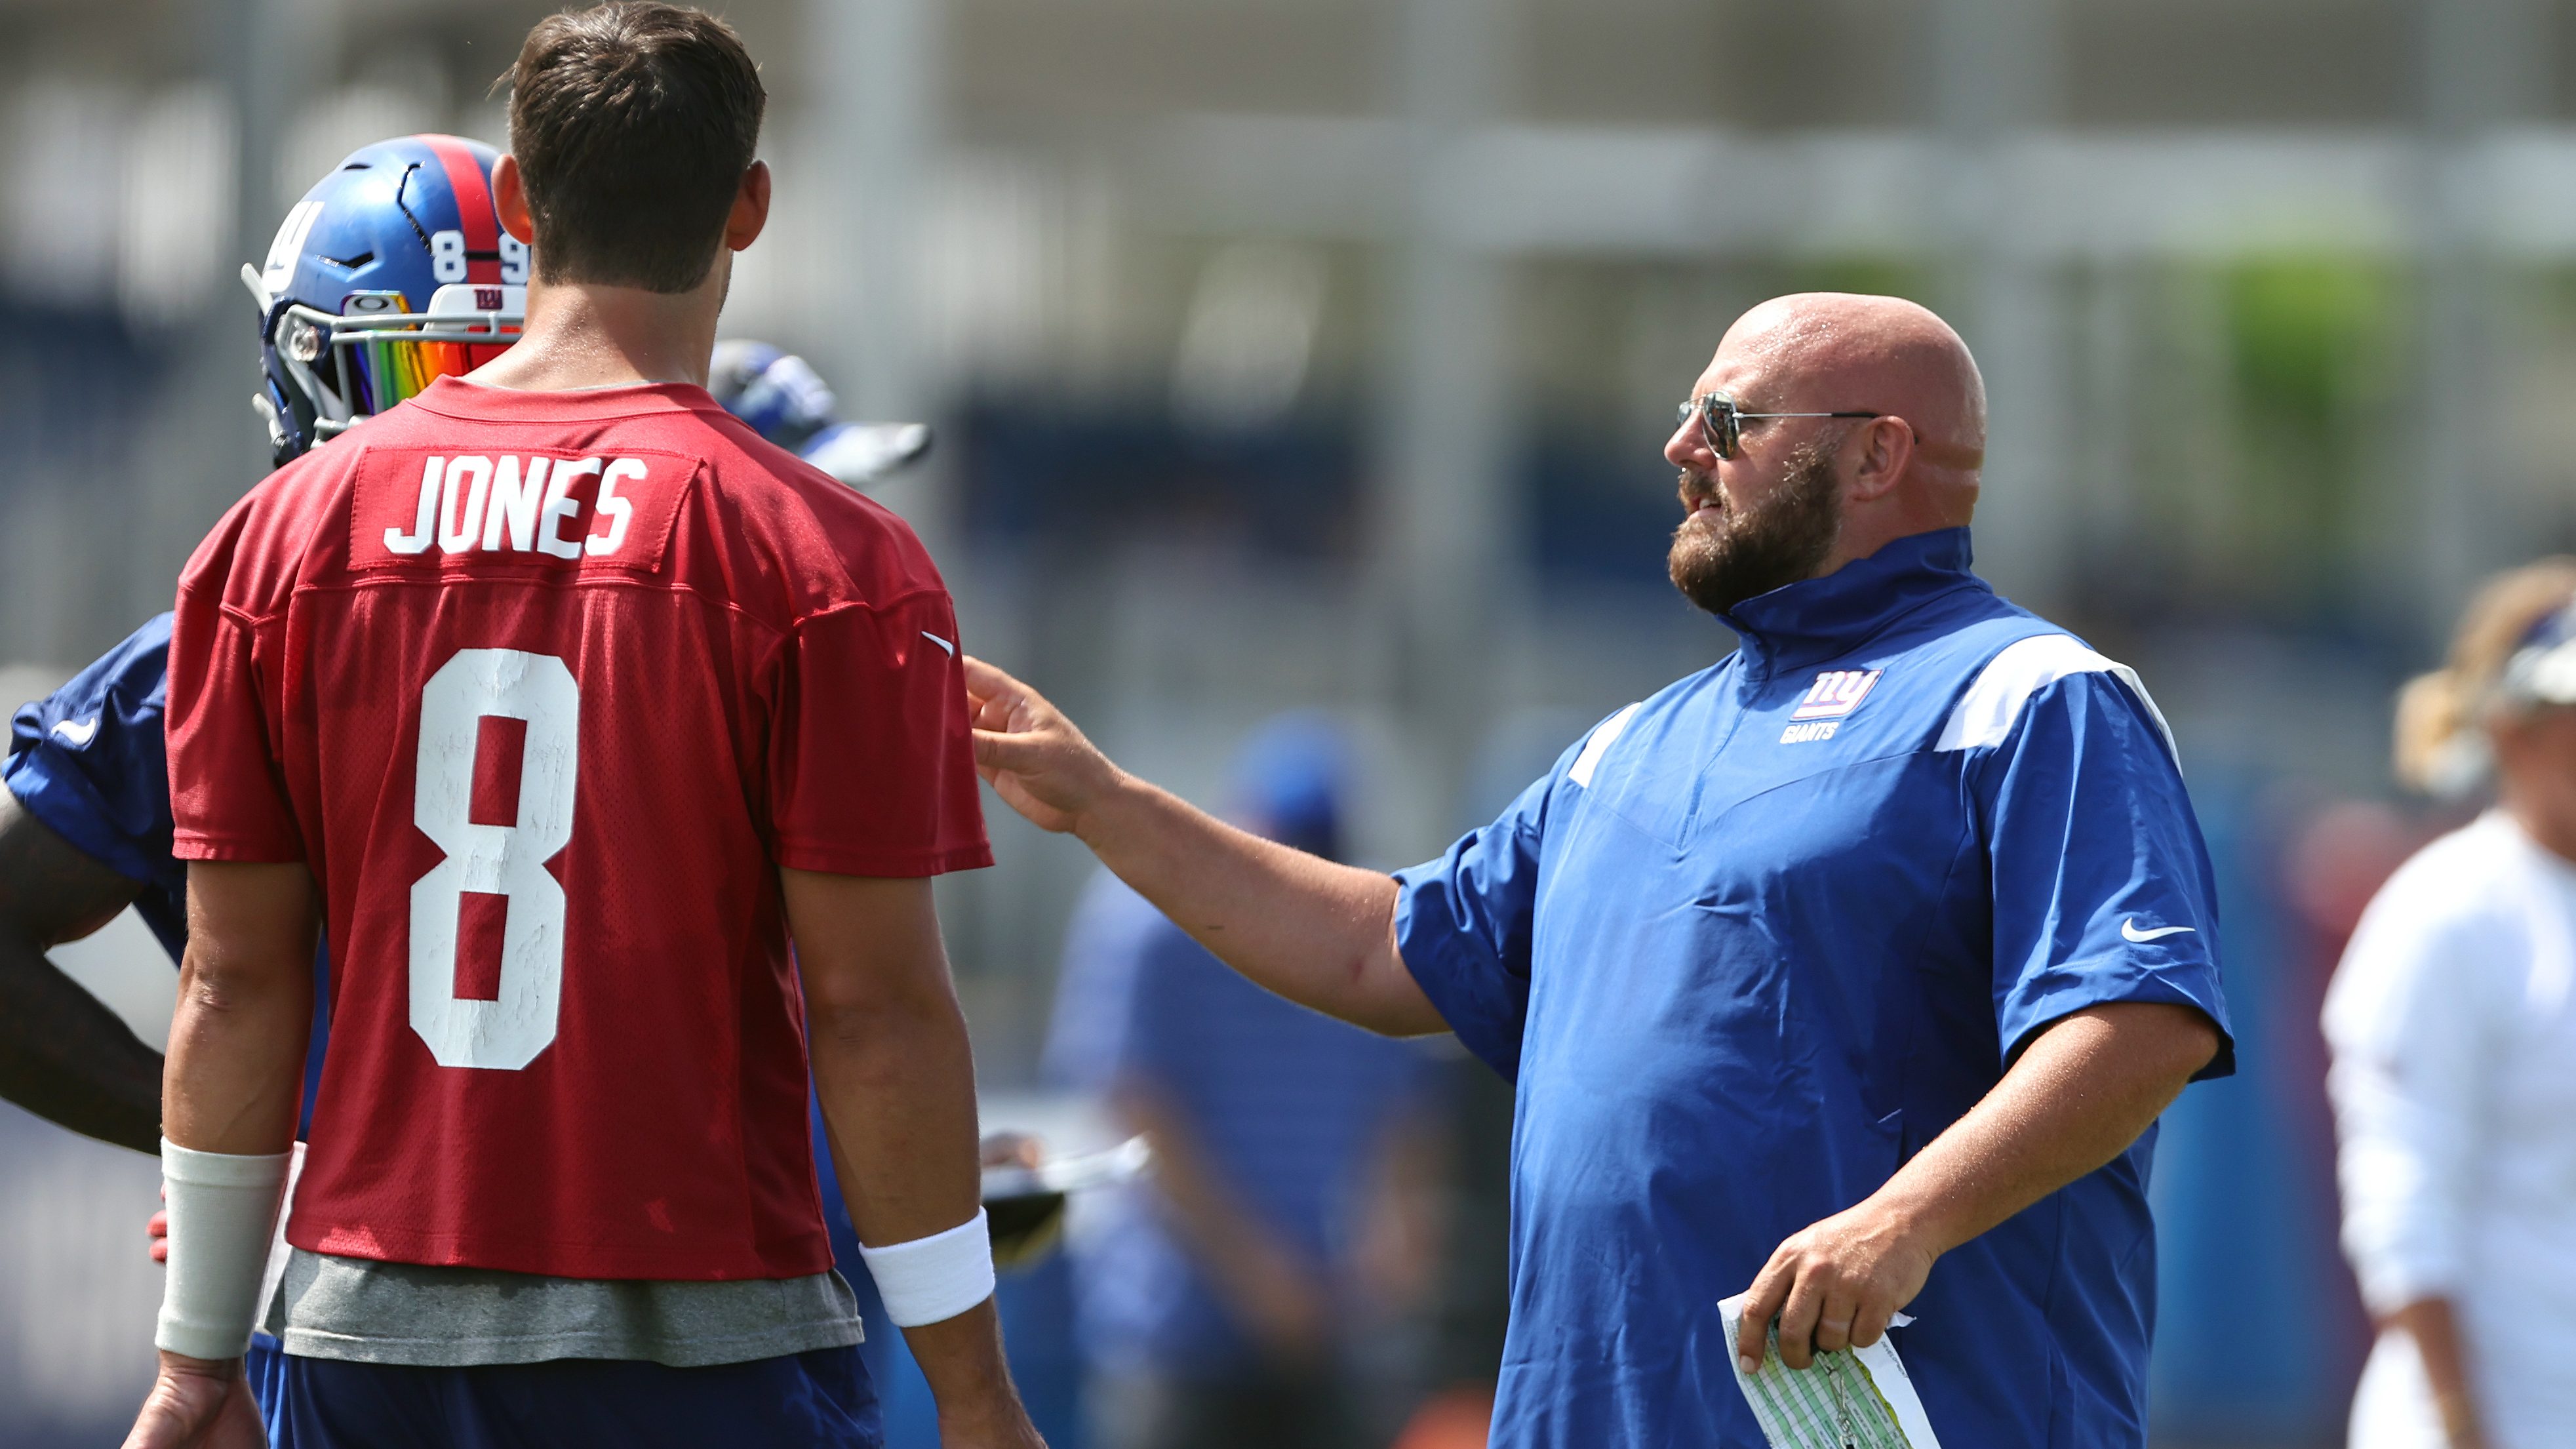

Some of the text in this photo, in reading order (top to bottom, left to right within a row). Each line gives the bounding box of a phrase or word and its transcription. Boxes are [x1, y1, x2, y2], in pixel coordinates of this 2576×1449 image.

[384, 455, 648, 559] JONES
[1779, 721, 1840, 744] GIANTS
[409, 648, 579, 1070] 8
